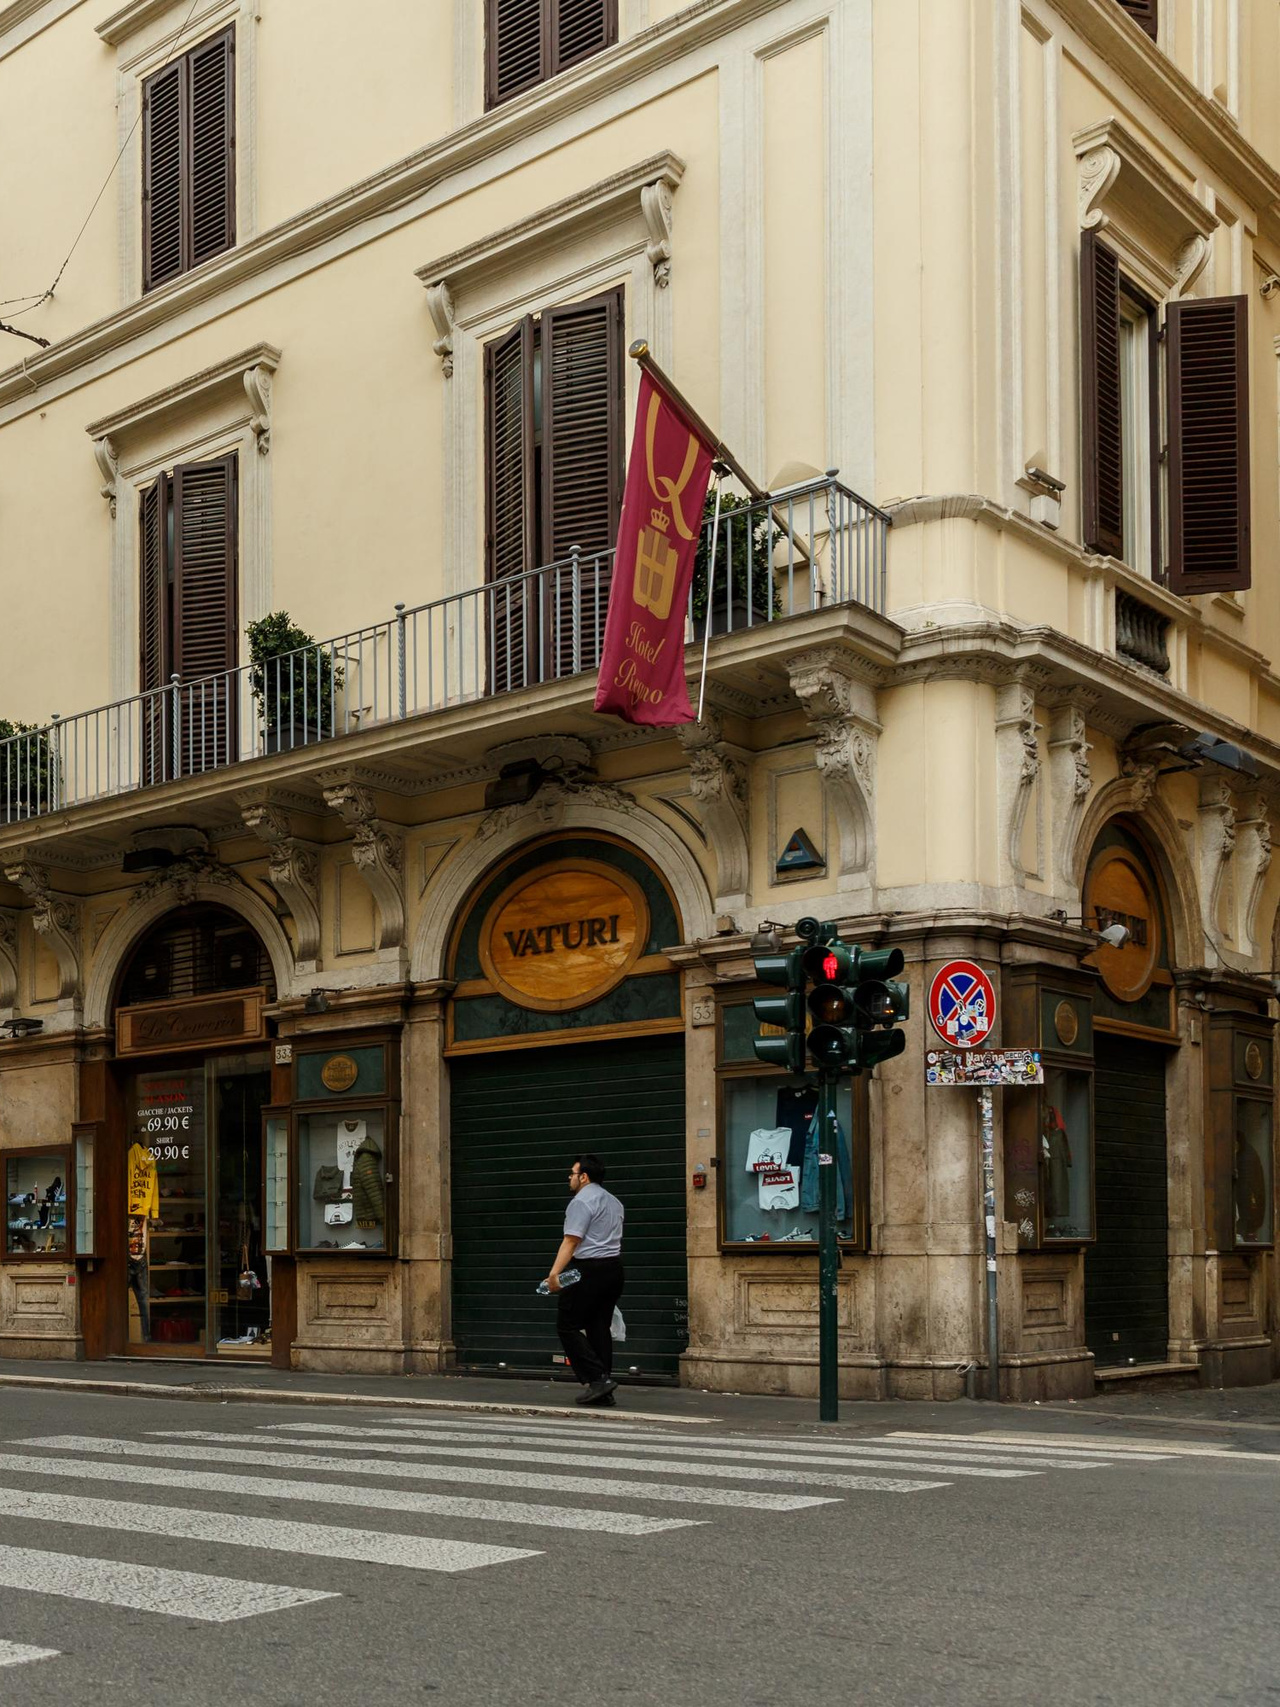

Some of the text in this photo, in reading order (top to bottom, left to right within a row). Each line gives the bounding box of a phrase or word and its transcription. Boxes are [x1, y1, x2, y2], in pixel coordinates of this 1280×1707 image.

[625, 621, 666, 665] Hotel
[614, 657, 666, 706] Regno
[504, 914, 620, 957] VATURI
[694, 1005, 714, 1020] 33
[966, 1051, 1004, 1061] Navna
[1005, 1052, 1023, 1060] GECO
[137, 1108, 164, 1117] GIACCHE
[167, 1106, 193, 1115] JACKETS
[147, 1116, 178, 1132] 69.90
[182, 1116, 189, 1130] €
[156, 1136, 174, 1144] SHIRT
[147, 1145, 178, 1161] 29.90
[182, 1145, 189, 1159] €
